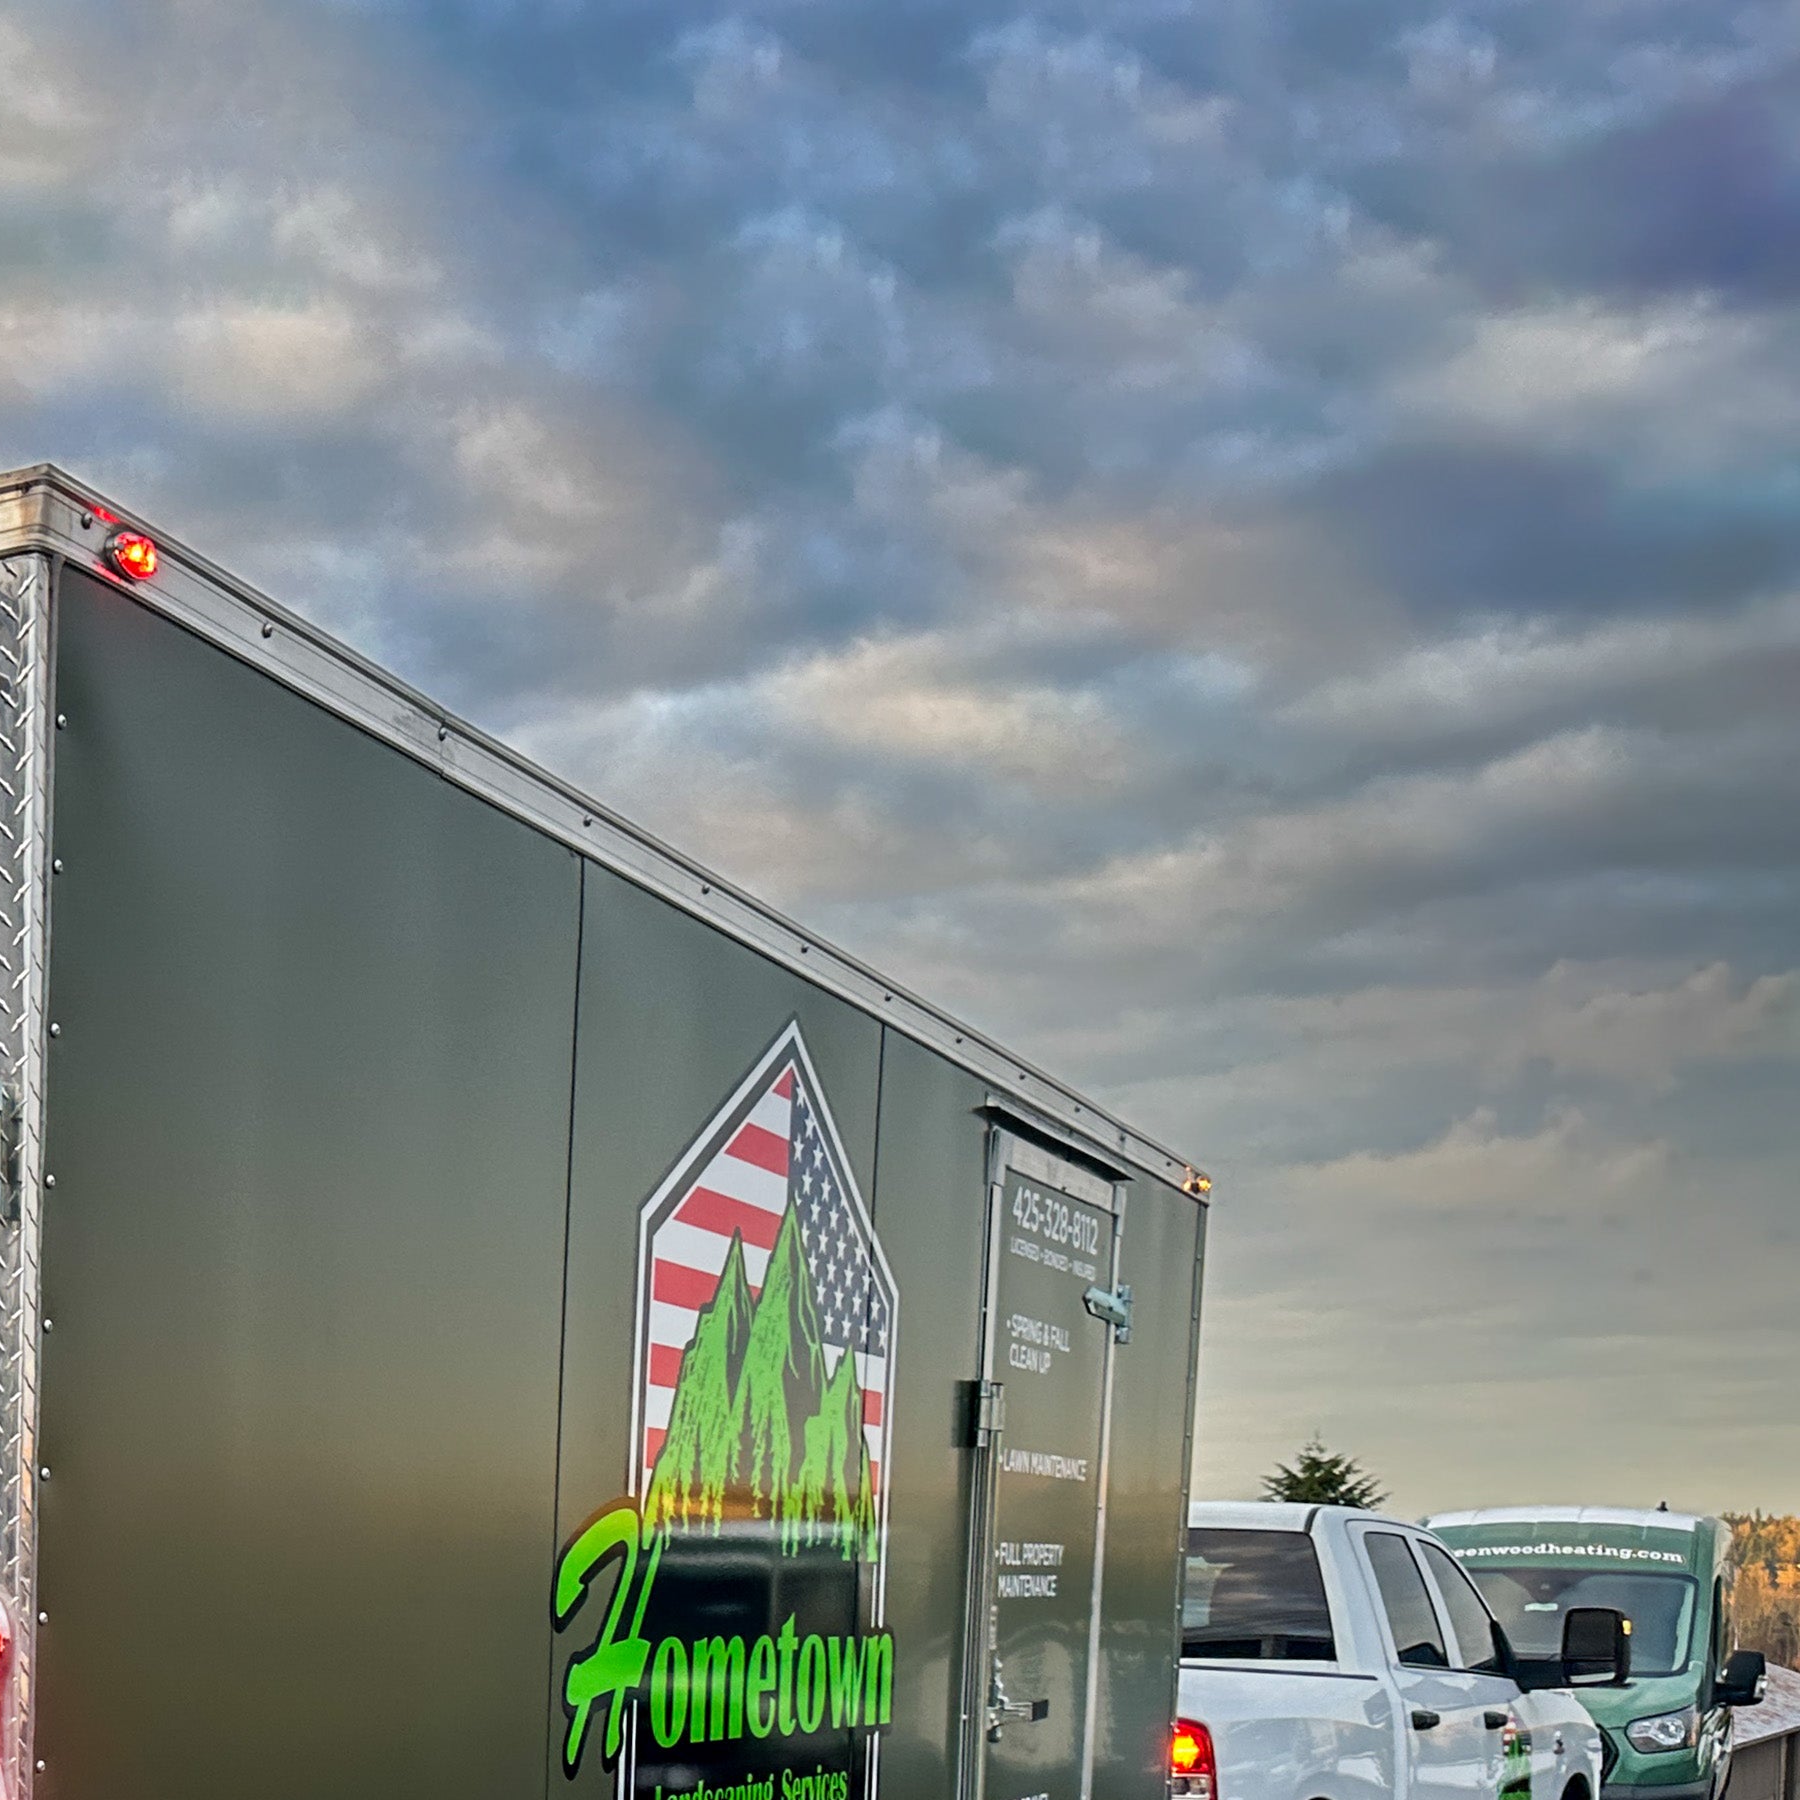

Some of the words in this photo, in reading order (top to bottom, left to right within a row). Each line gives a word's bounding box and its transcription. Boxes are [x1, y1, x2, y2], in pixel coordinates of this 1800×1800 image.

[1013, 1186, 1099, 1255] 425-328-8112
[1011, 1314, 1042, 1345] SPRING
[1050, 1325, 1071, 1353] FALL
[1009, 1342, 1038, 1372] CLEAN
[1038, 1351, 1051, 1374] UP
[1003, 1448, 1030, 1474] LAWN
[1030, 1452, 1087, 1482] MAINTENANCE
[1000, 1542, 1021, 1566] FULL
[1022, 1543, 1065, 1567] PROPERTY
[997, 1575, 1058, 1598] MAINTENANCE
[556, 1508, 894, 1767] Hometown
